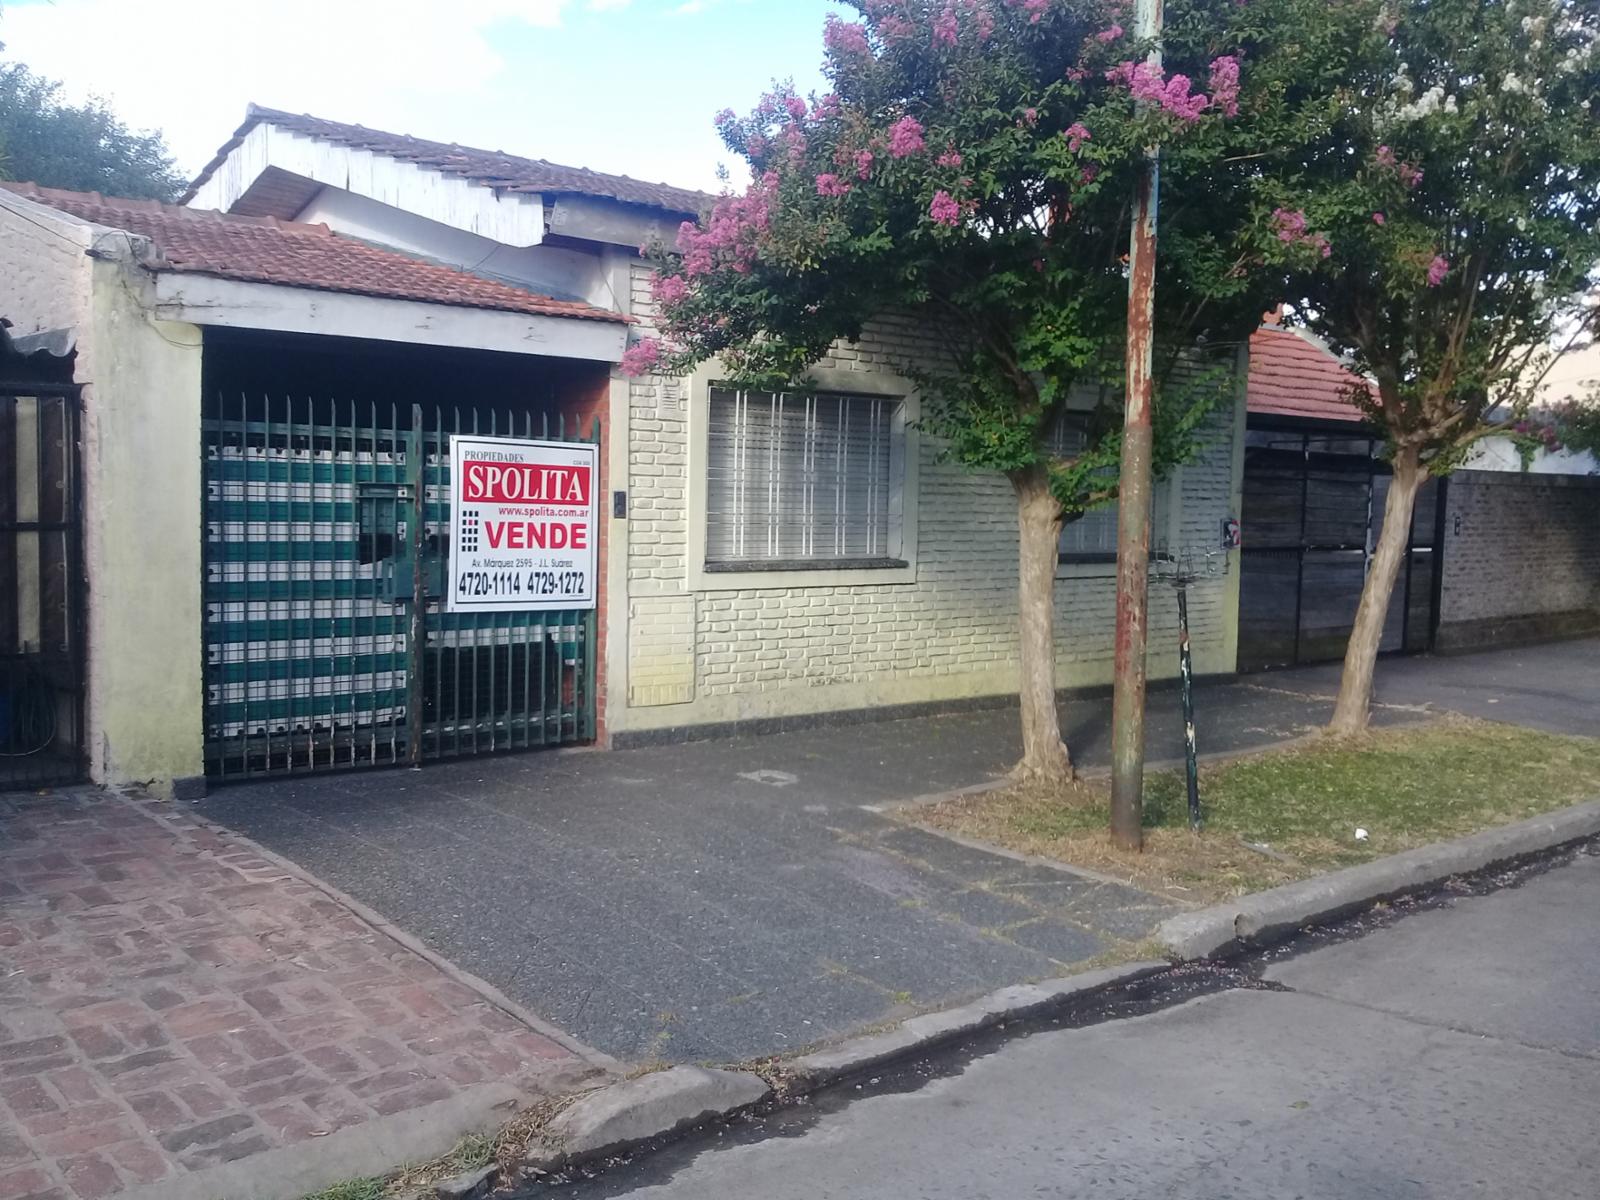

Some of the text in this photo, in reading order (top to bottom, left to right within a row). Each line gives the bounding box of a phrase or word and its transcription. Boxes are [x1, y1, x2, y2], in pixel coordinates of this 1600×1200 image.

[464, 450, 524, 462] PROPIEDADES
[468, 465, 584, 501] SPOLITA
[498, 506, 589, 518] www.spolita.com.ar
[484, 521, 587, 549] VENDE
[472, 558, 482, 568] Av.
[516, 558, 533, 568] 2595
[459, 571, 585, 596] 4720-1114 4729-1272
